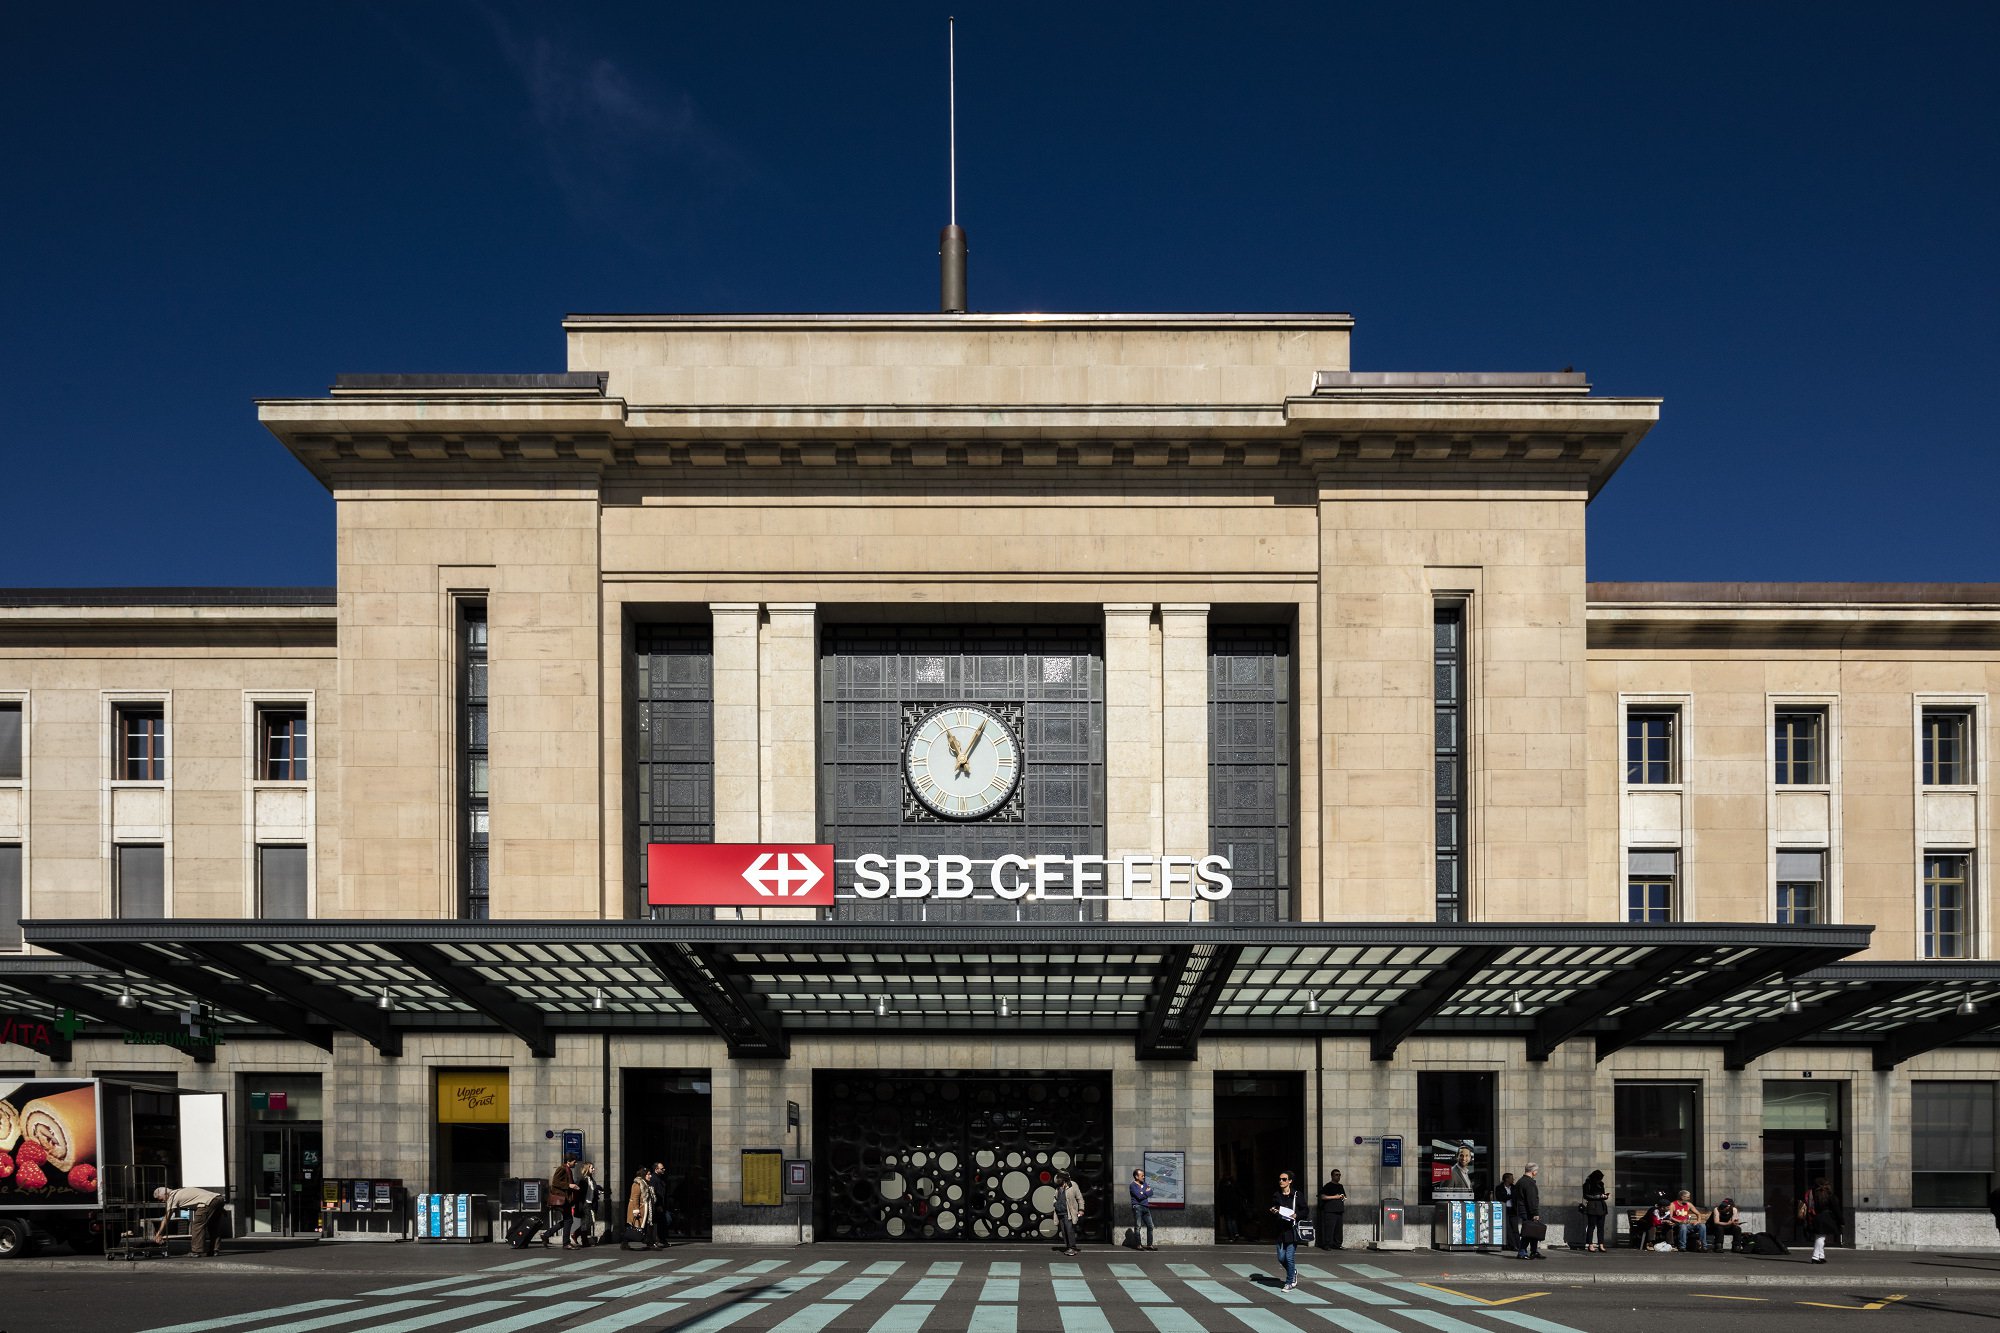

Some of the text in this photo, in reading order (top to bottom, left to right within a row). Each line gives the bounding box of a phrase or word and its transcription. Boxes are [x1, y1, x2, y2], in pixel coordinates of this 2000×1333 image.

[853, 853, 1233, 901] SBB CFF FFS
[124, 1031, 226, 1048] PARFUMERIE
[457, 1087, 487, 1102] Upper
[469, 1094, 496, 1109] Crust
